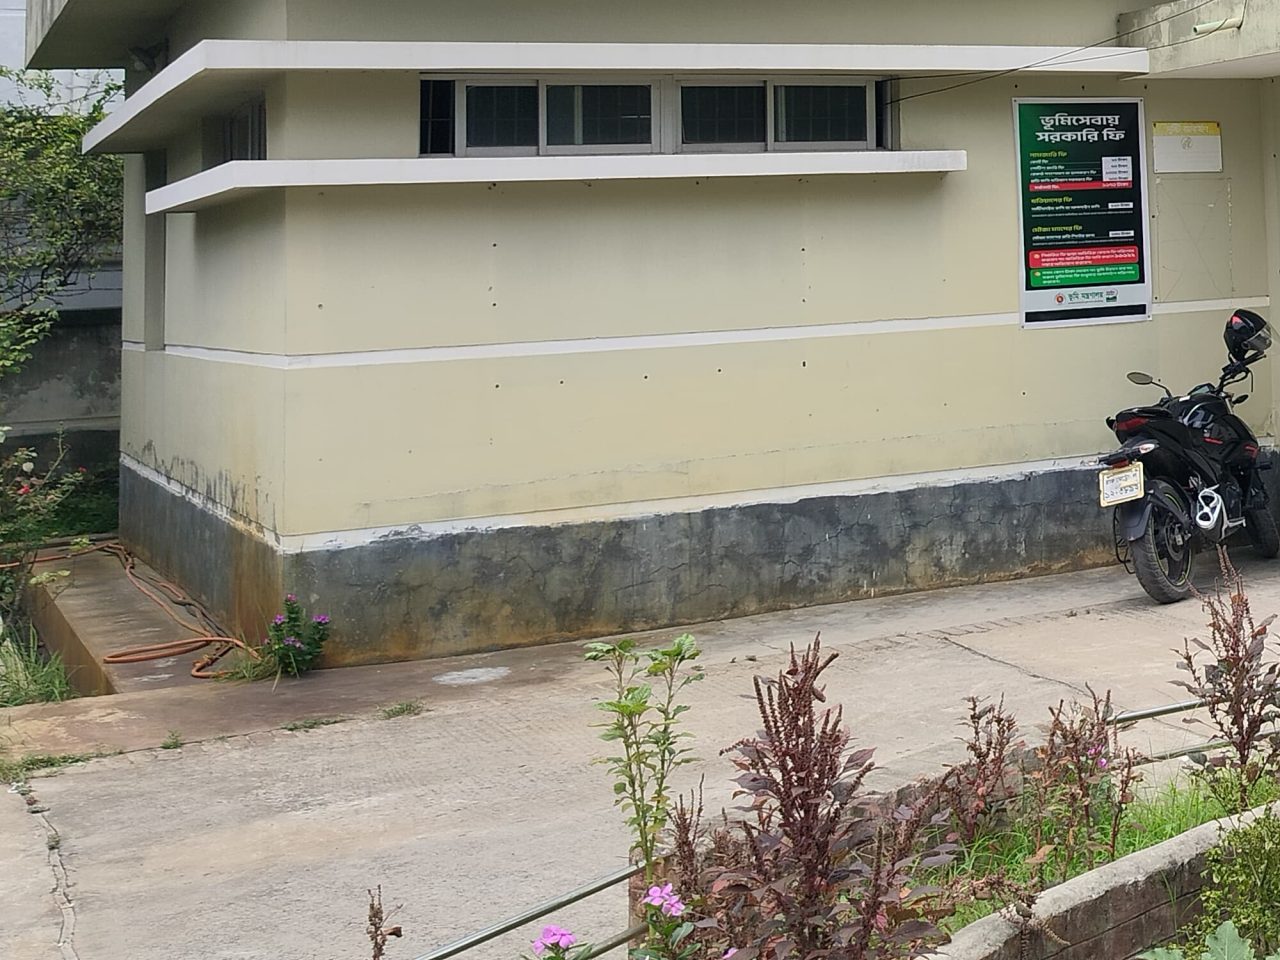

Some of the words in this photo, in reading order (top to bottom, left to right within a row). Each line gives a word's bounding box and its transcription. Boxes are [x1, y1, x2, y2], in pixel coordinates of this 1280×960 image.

[1039, 112, 1120, 130] ভূমিসেবায়
[1035, 127, 1099, 143] সরকারি
[1102, 127, 1125, 142] ফি
